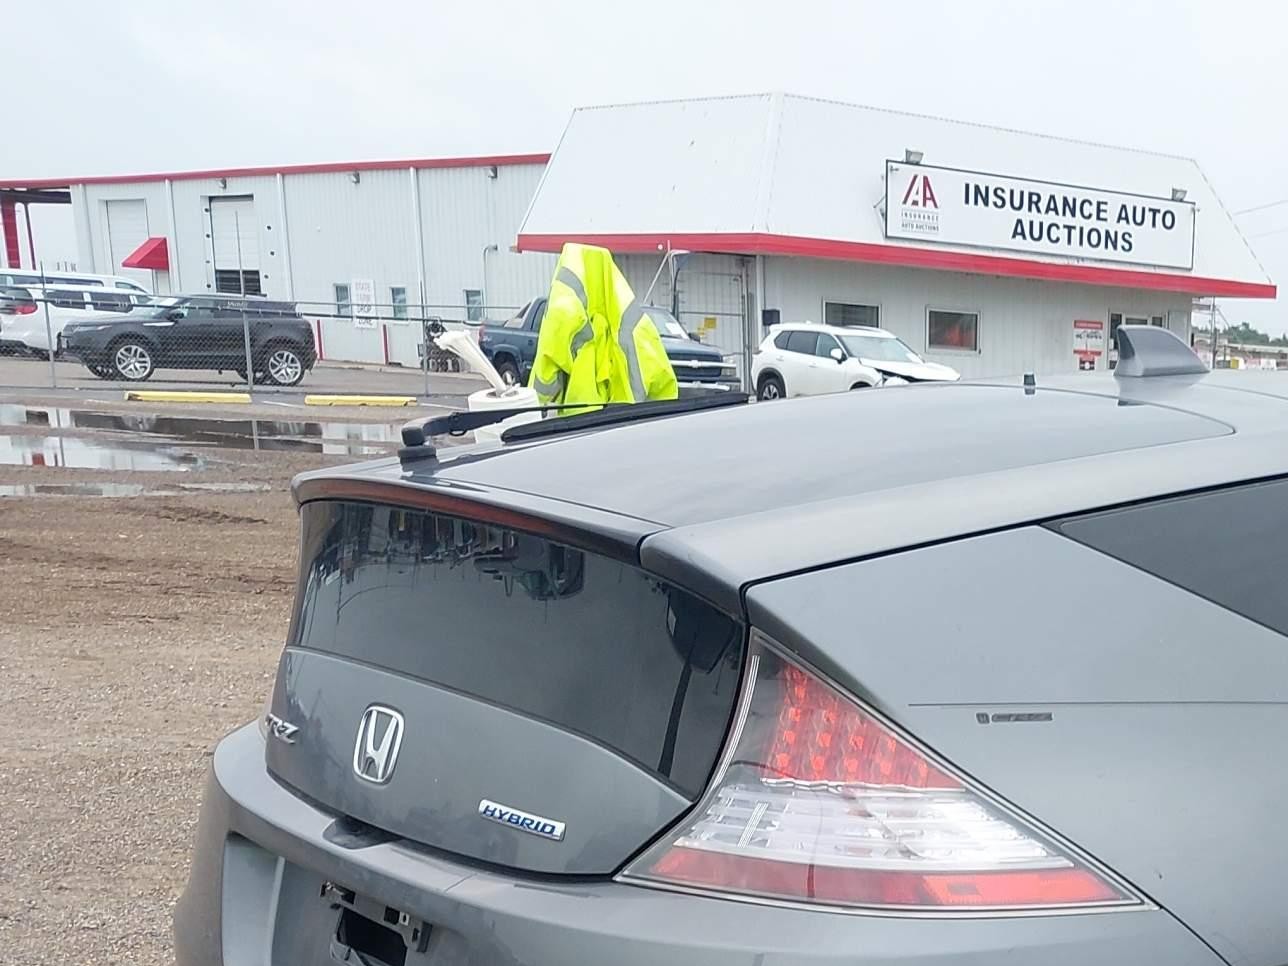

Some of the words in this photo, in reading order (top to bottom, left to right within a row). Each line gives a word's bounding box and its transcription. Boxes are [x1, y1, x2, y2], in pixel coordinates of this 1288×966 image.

[964, 183, 1108, 222] INSURANCE
[1116, 203, 1176, 231] AUTO
[1011, 218, 1133, 252] AUCTIONS
[483, 804, 556, 835] HYBRID
